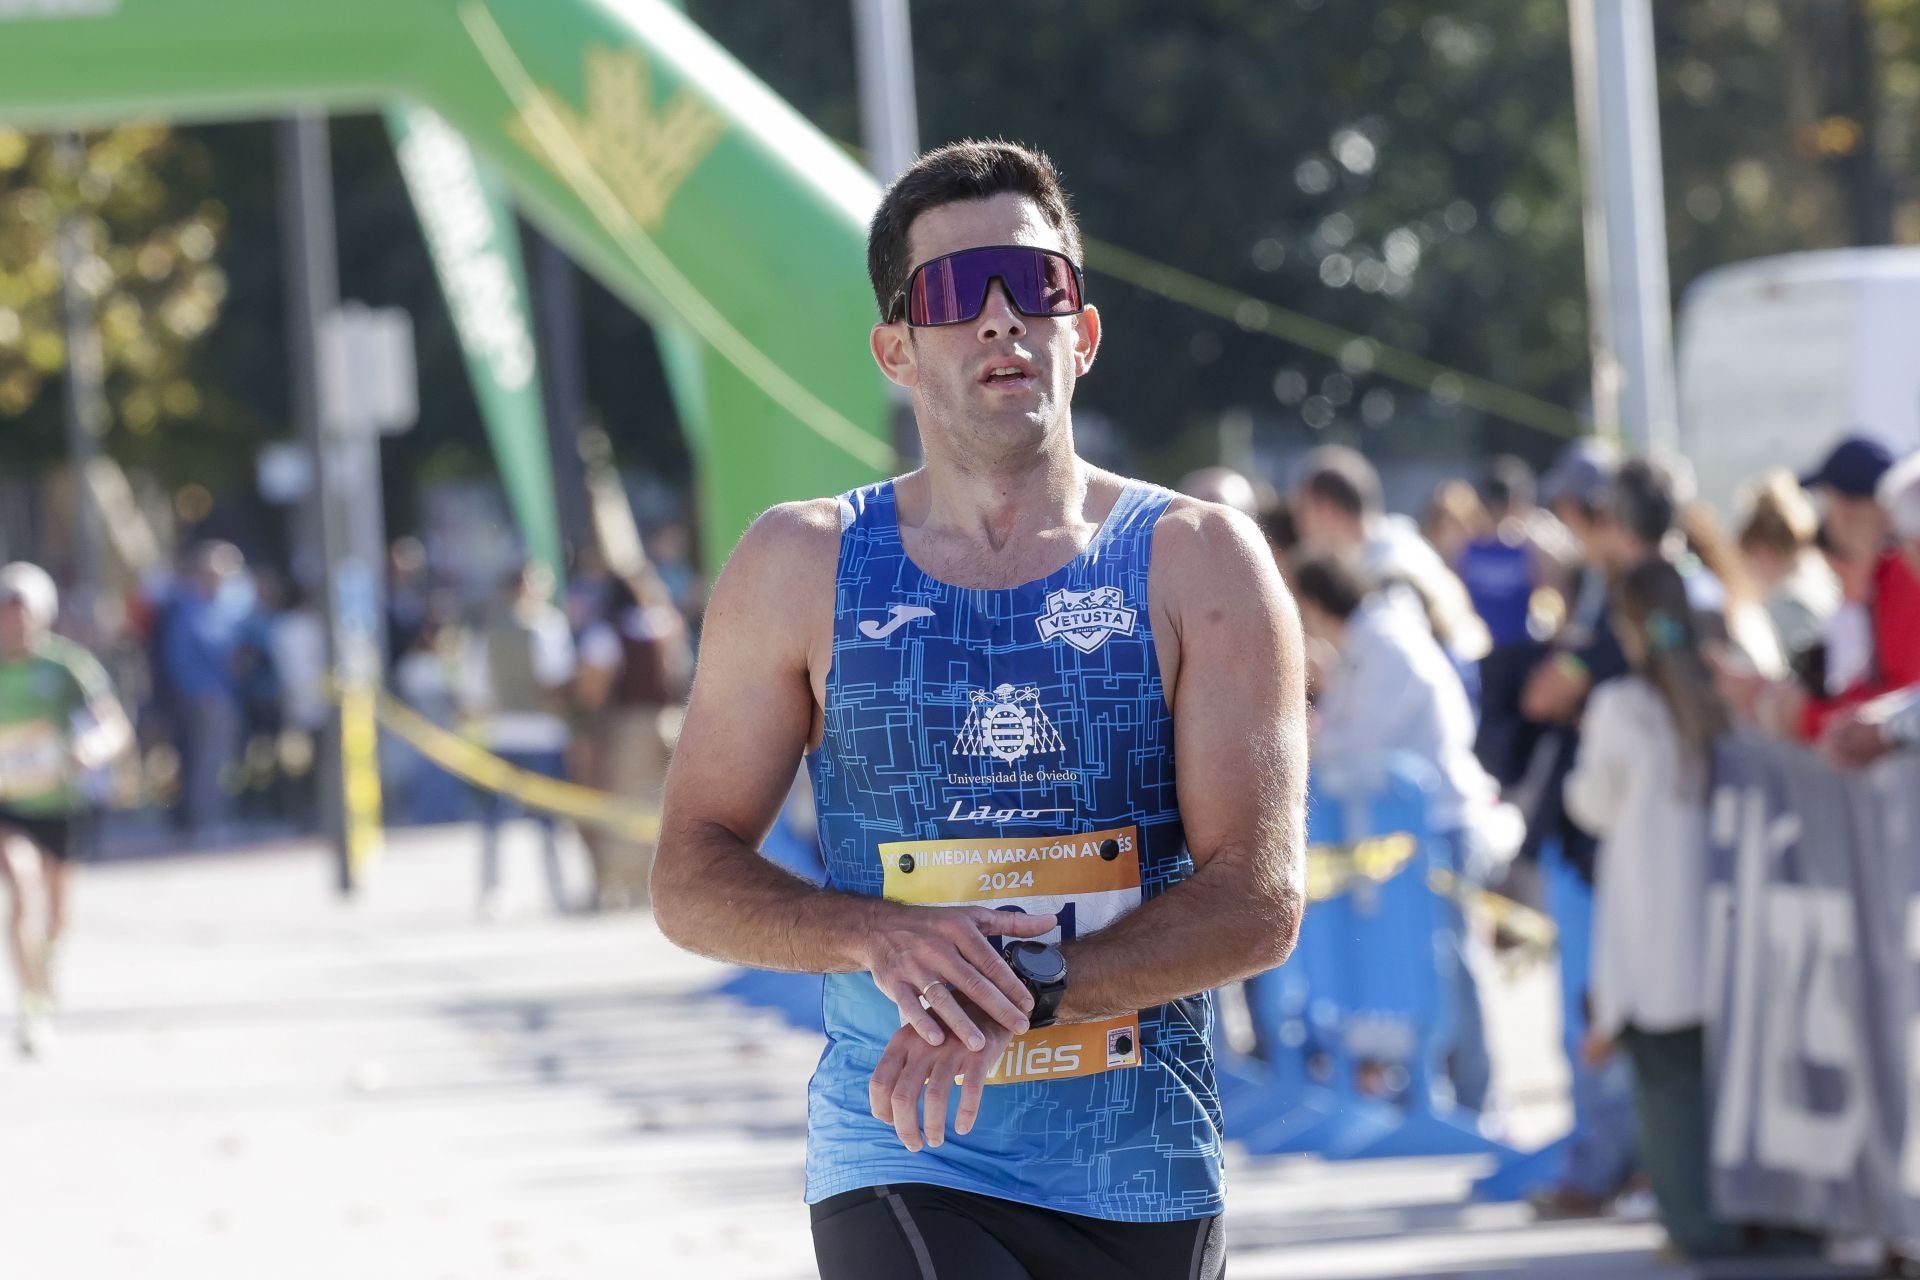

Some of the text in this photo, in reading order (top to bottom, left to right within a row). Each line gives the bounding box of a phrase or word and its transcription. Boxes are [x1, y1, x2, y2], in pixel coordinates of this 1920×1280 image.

[1050, 611, 1124, 628] VETUSTA
[948, 770, 1077, 785] Universidad de Oviedo
[947, 800, 1075, 823] Lago
[932, 849, 984, 867] MEDIA
[987, 842, 1076, 864] MARATÓN
[1080, 833, 1132, 858] AVÉS
[978, 870, 1034, 892] 2024
[985, 1040, 1082, 1079] vilés
